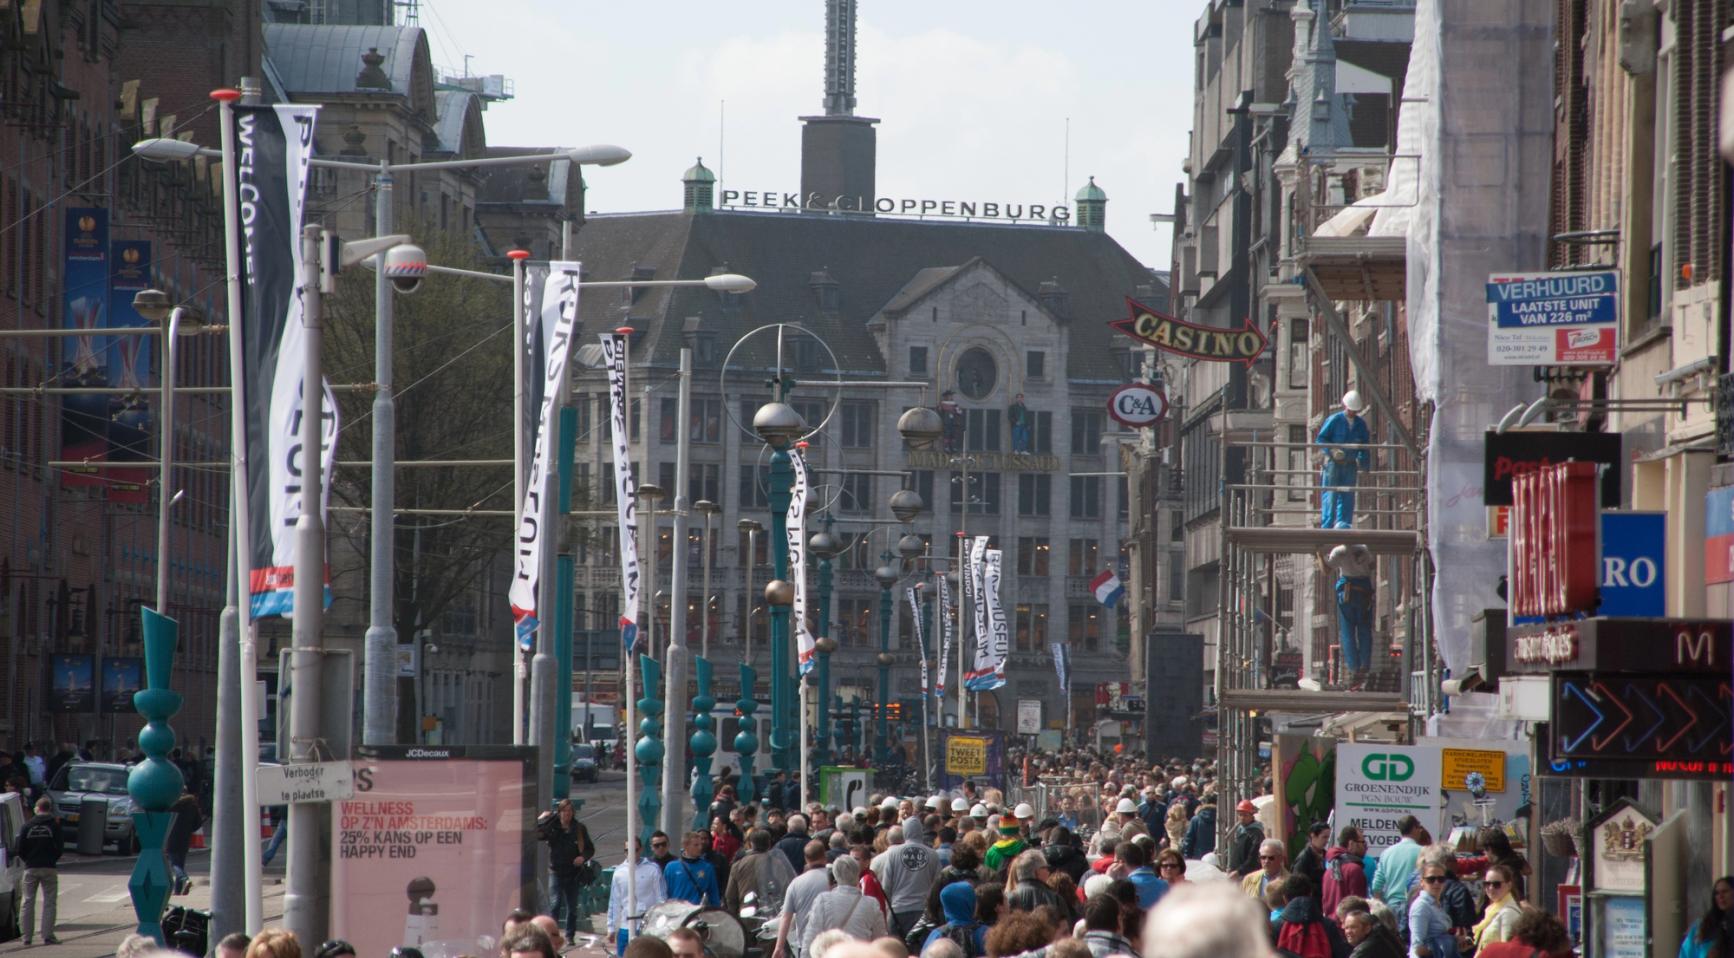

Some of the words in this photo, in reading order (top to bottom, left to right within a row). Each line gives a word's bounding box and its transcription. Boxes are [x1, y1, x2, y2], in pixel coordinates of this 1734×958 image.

[723, 190, 799, 208] PEEK
[835, 194, 1071, 221] CLOPPENBURG
[1498, 276, 1605, 300] VERHUURD
[1512, 300, 1567, 314] LAATSTE
[1570, 298, 1600, 310] UNIT
[1520, 313, 1547, 325] VAN
[1550, 312, 1572, 324] 226
[1134, 313, 1261, 356] CASINO
[1118, 394, 1157, 416] C&A
[405, 749, 449, 758] JCDecaux
[951, 748, 980, 757] TWEET
[1361, 753, 1415, 781] GD
[281, 791, 290, 801] te
[1345, 783, 1430, 797] GROENENDIJK
[1361, 794, 1381, 803] PGN
[1384, 794, 1413, 804] BOUW
[340, 801, 413, 815] WELLNESS
[340, 816, 359, 829] OP
[362, 816, 385, 829] Z'N
[387, 816, 488, 830] AMSTERDAMS:
[340, 831, 370, 844] 25%
[373, 831, 411, 844] KANS
[415, 831, 433, 844] OP
[436, 831, 462, 844] EEN
[340, 845, 385, 859] HAPPY
[389, 845, 416, 859] END
